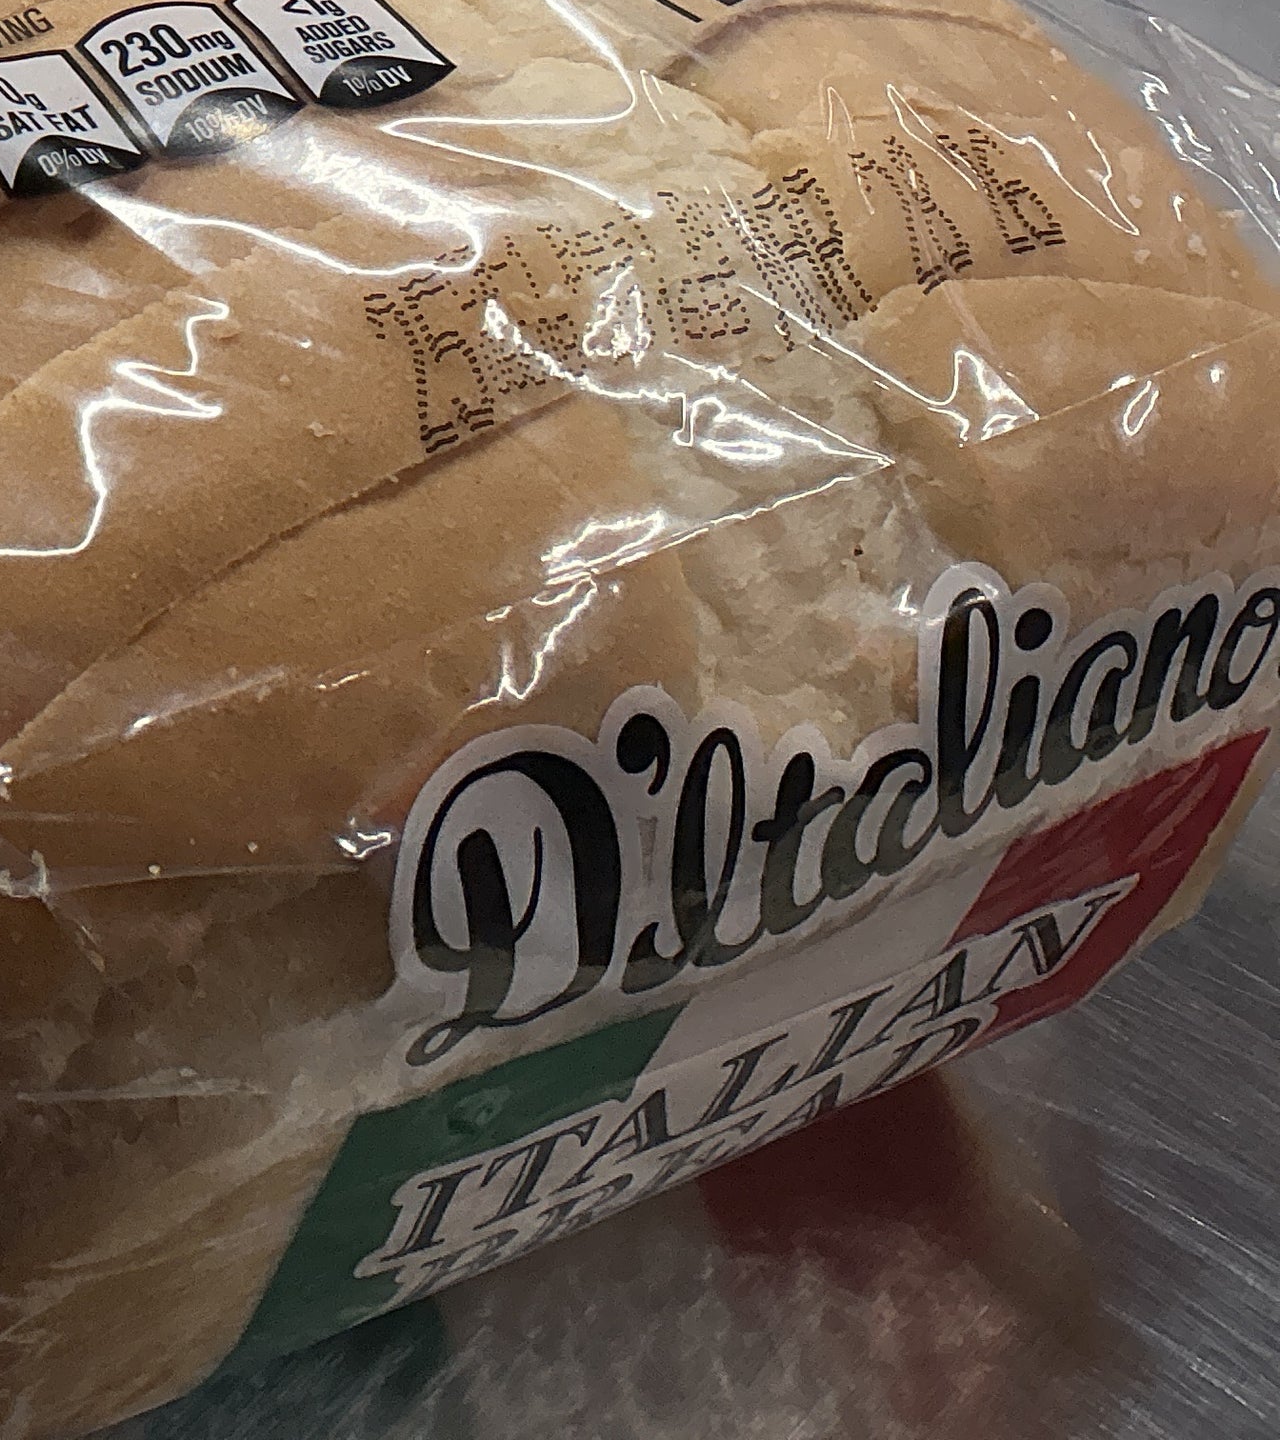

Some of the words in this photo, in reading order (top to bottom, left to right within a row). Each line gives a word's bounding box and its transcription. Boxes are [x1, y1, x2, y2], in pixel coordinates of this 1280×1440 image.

[297, 15, 371, 43] ADDED
[303, 31, 396, 64] SUGARS
[136, 54, 259, 106] SODIUM
[45, 104, 100, 134] FAT
[406, 587, 1280, 1067] D'Italiano
[382, 888, 1128, 1261] ITALIAN
